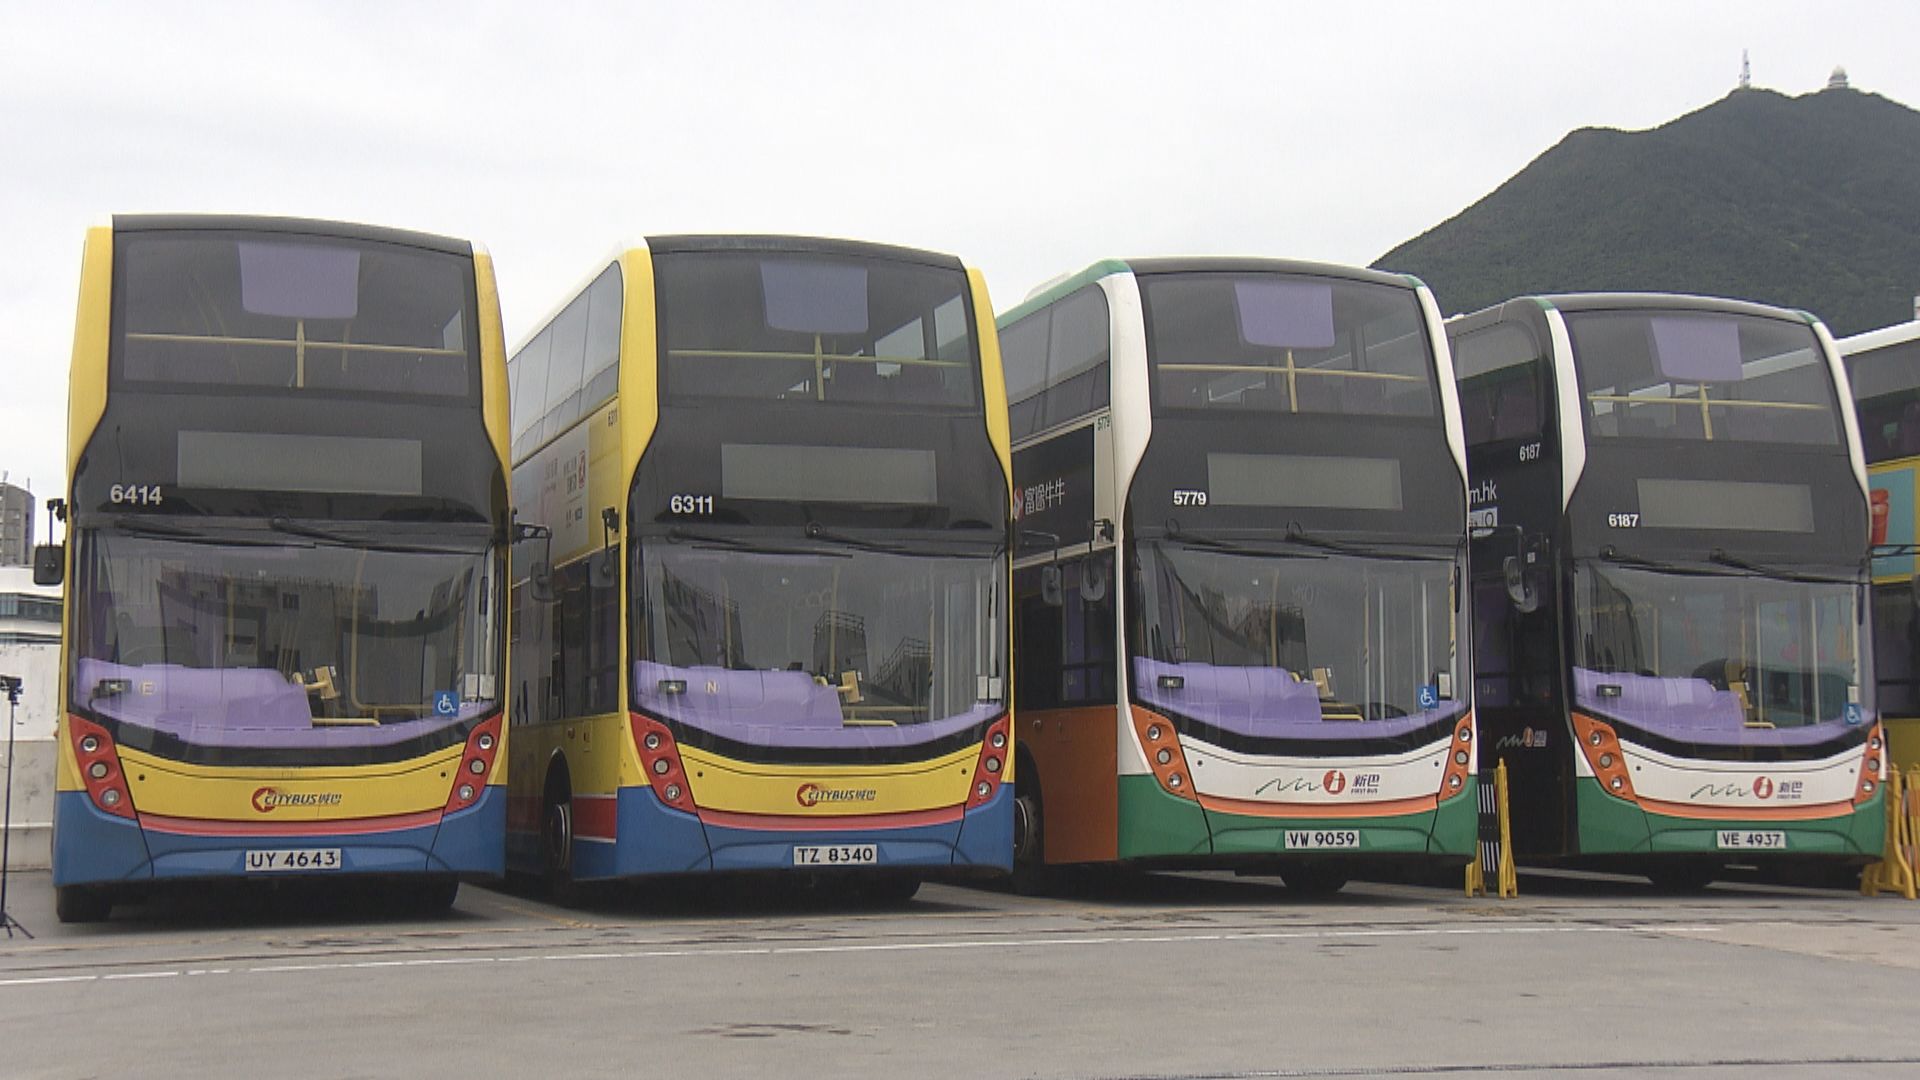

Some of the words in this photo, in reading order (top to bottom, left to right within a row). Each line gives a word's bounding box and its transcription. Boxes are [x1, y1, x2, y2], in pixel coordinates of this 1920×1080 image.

[1519, 442, 1541, 462] 6187
[110, 484, 163, 505] 6414
[1025, 478, 1065, 515] 富途牛牛
[1173, 490, 1207, 505] 5779
[670, 495, 713, 514] 6311
[1608, 513, 1639, 528] 6187
[1352, 774, 1380, 788] 新巴
[1290, 832, 1309, 847] VW
[1315, 832, 1355, 845] 9059
[1722, 832, 1740, 846] VE
[1746, 833, 1781, 846] 4937
[251, 852, 276, 867] UY
[284, 851, 335, 867] 4643
[798, 848, 820, 863] TZ
[828, 848, 873, 862] 8340
